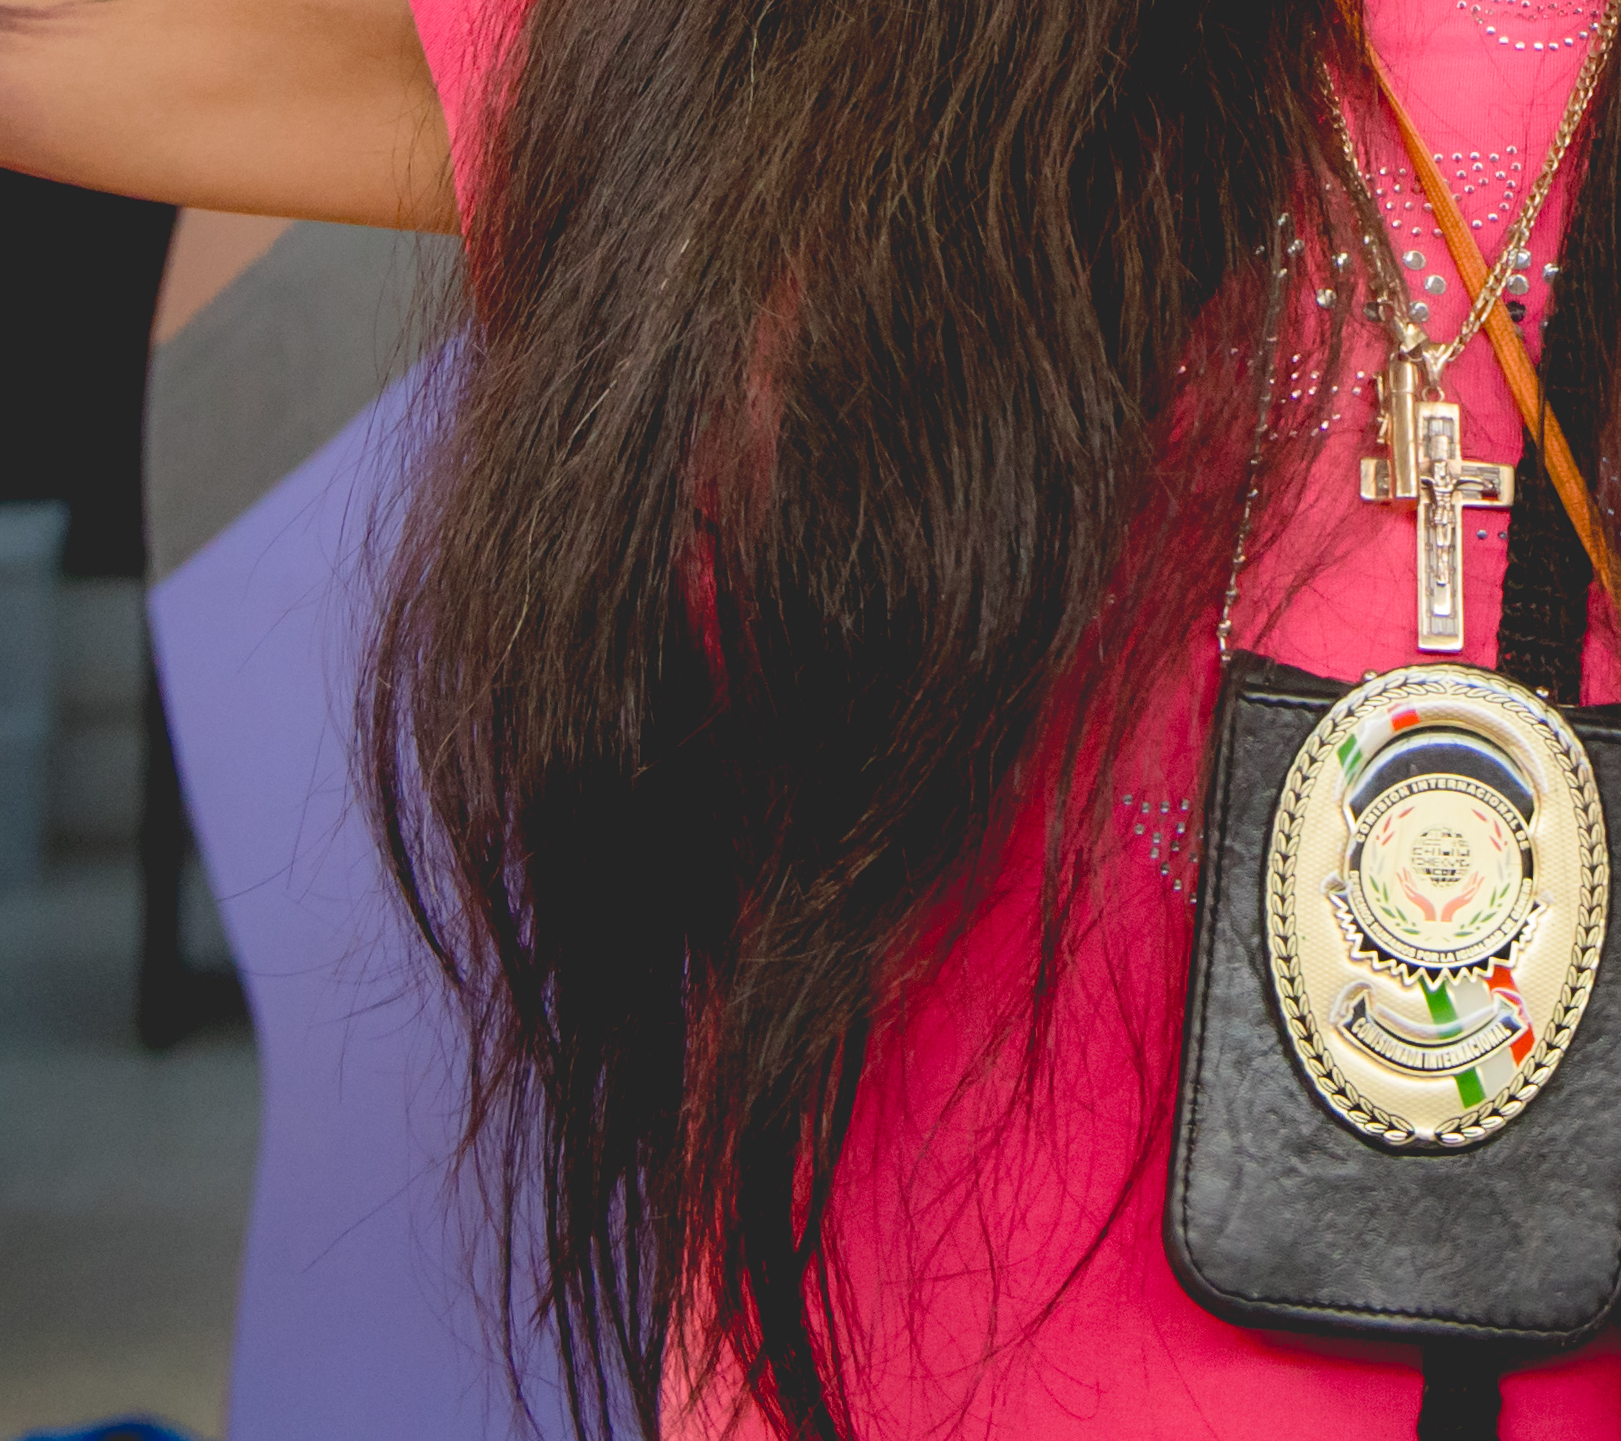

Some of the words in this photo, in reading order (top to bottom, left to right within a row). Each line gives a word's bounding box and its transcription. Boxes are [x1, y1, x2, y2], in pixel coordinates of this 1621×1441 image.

[1354, 785, 1410, 843] COMISION
[1410, 777, 1518, 830] INTERNACIONAL
[1515, 829, 1530, 850] DE
[1416, 949, 1440, 963] POR
[1440, 951, 1456, 963] LA
[1424, 1022, 1512, 1069] INTERNACIONAL
